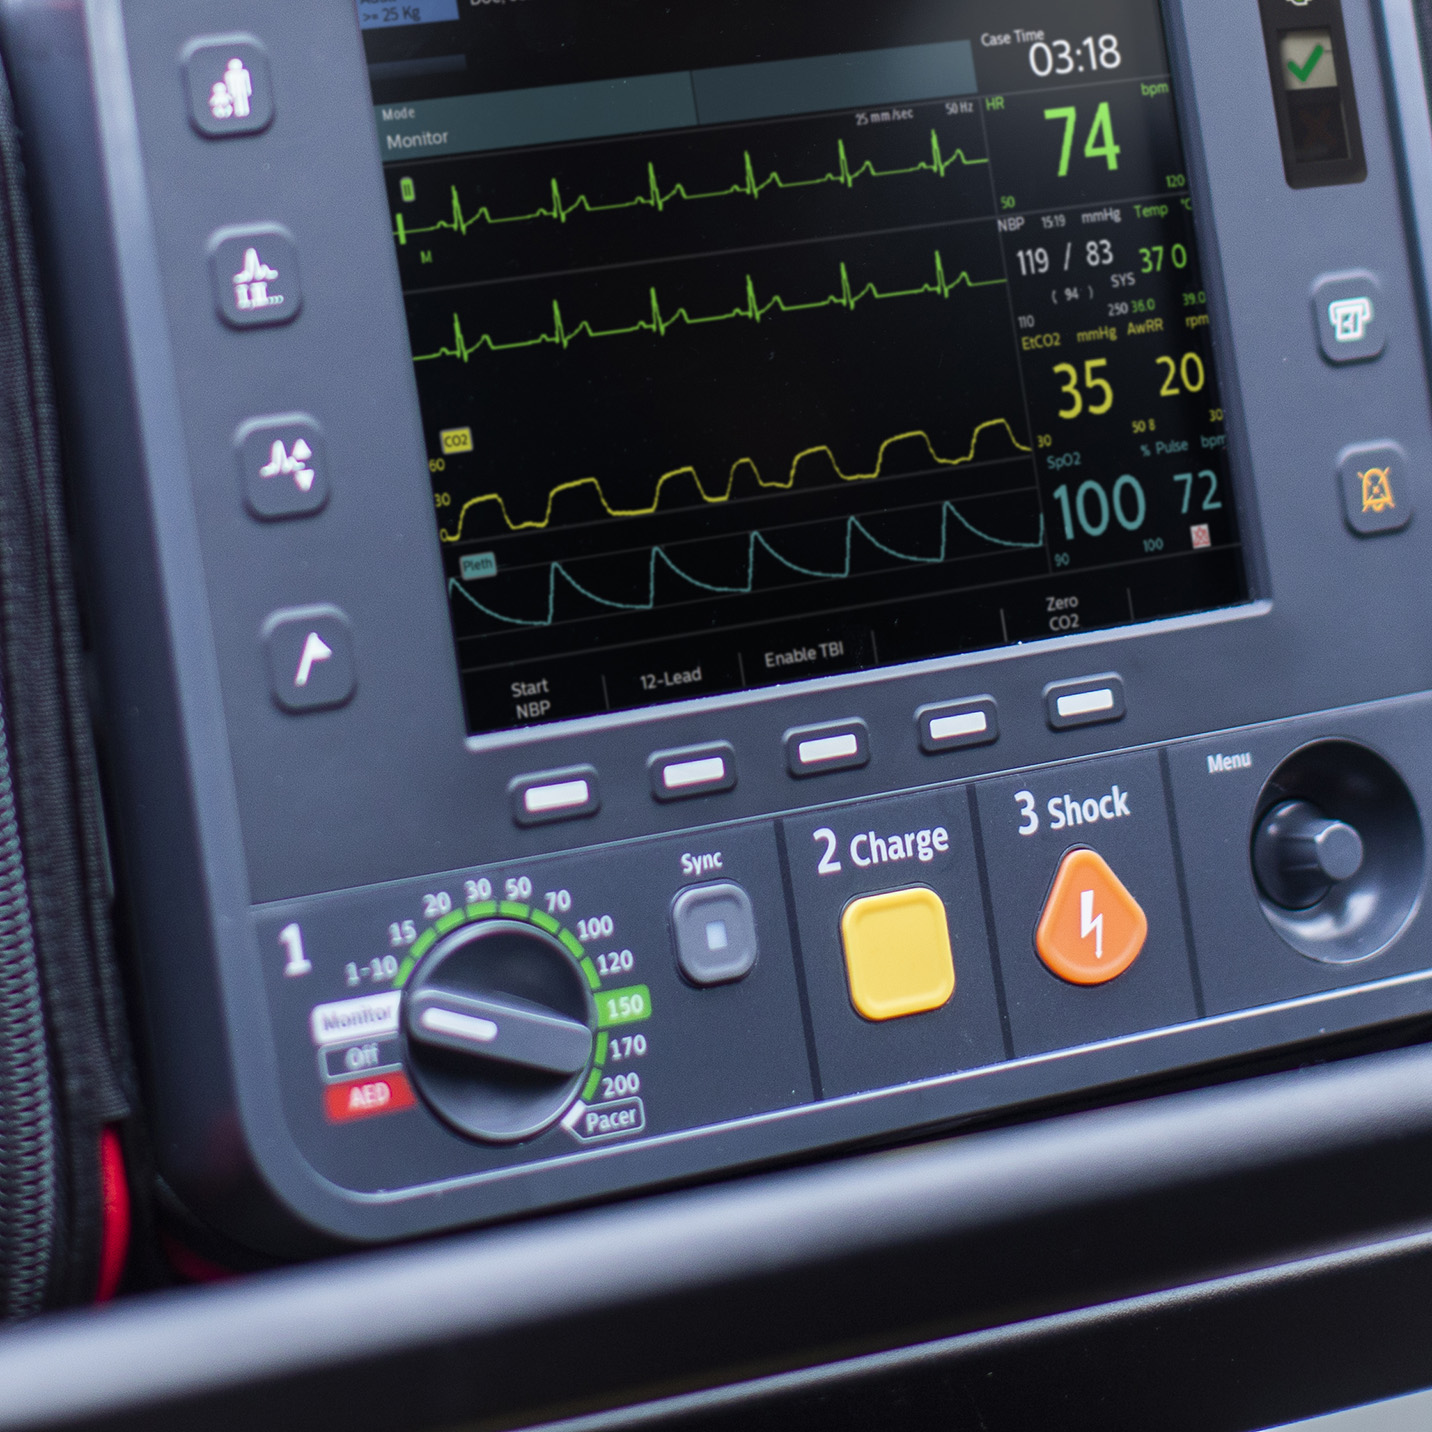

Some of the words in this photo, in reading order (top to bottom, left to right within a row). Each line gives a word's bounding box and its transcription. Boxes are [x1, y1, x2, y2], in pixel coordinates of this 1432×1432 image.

[382, 8, 399, 22] 25
[402, 6, 420, 22] Kg
[981, 32, 1011, 47] Case
[1013, 29, 1044, 43] Time
[1029, 34, 1122, 77] 03:18
[1140, 82, 1170, 98] bpm
[945, 102, 959, 115] 50
[961, 101, 973, 113] Hz
[985, 96, 1005, 110] HR
[382, 107, 415, 121] Mode
[855, 112, 869, 125] 25
[386, 130, 449, 150] Monitor
[1044, 102, 1121, 177] 74
[1166, 174, 1186, 188] 120
[1001, 196, 1016, 209] 50
[1134, 203, 1168, 219] Temp
[997, 217, 1025, 232] NBP
[1081, 207, 1121, 224] mmHg
[420, 250, 433, 264] M
[1016, 247, 1050, 276] 119
[1063, 242, 1072, 271] /
[1086, 239, 1114, 266] 83
[1111, 272, 1136, 288] SYS
[1107, 302, 1129, 316] 250
[1131, 298, 1156, 314] 36.0
[1182, 291, 1206, 306] 39.0
[1018, 315, 1035, 329] 110
[1127, 318, 1165, 335] AwRR
[1185, 314, 1209, 330] rpm
[1021, 333, 1062, 351] EtCO2
[1076, 325, 1117, 342] mmHg
[1155, 352, 1205, 397] 20
[1052, 357, 1114, 419] 35
[1148, 419, 1156, 432] 8
[1209, 409, 1223, 422] 30
[1131, 420, 1147, 434] 50
[443, 434, 469, 448] CO2
[1037, 434, 1052, 448] 30
[1155, 439, 1189, 455] Pulse
[429, 458, 445, 472] 60
[1046, 451, 1082, 470] SpO2
[1140, 444, 1151, 457] %
[434, 492, 451, 507] 30
[1173, 469, 1222, 514] 72
[1053, 473, 1146, 541] 100
[1142, 537, 1164, 553] 100
[463, 558, 493, 573] Pleth
[1054, 553, 1070, 567] 90
[1045, 596, 1079, 612] Zero
[1049, 614, 1081, 631] CO2
[764, 647, 817, 669] Enable
[819, 641, 845, 660] TBI
[511, 678, 550, 698] Start
[640, 666, 703, 690] 12-Lead
[516, 700, 551, 720] NBP
[1207, 750, 1252, 775] Menu
[1013, 790, 1040, 837] 3
[1047, 784, 1131, 831] Shock
[813, 826, 842, 875] 2
[849, 824, 951, 869] Charge
[681, 849, 724, 875] Sync
[464, 877, 492, 901] 30
[505, 876, 532, 900] 50
[423, 891, 452, 917] 20
[545, 889, 571, 913] 70
[389, 919, 417, 947] 15
[576, 914, 614, 940] 100
[279, 923, 312, 977] 1
[345, 955, 398, 987] 1-10
[597, 949, 634, 975] 120
[607, 993, 645, 1018] 150
[323, 1006, 392, 1030] Monitor
[346, 1042, 379, 1070] Off
[611, 1034, 648, 1060] 170
[349, 1082, 391, 1109] AED
[602, 1072, 640, 1099] 200
[586, 1105, 637, 1133] Pacer
